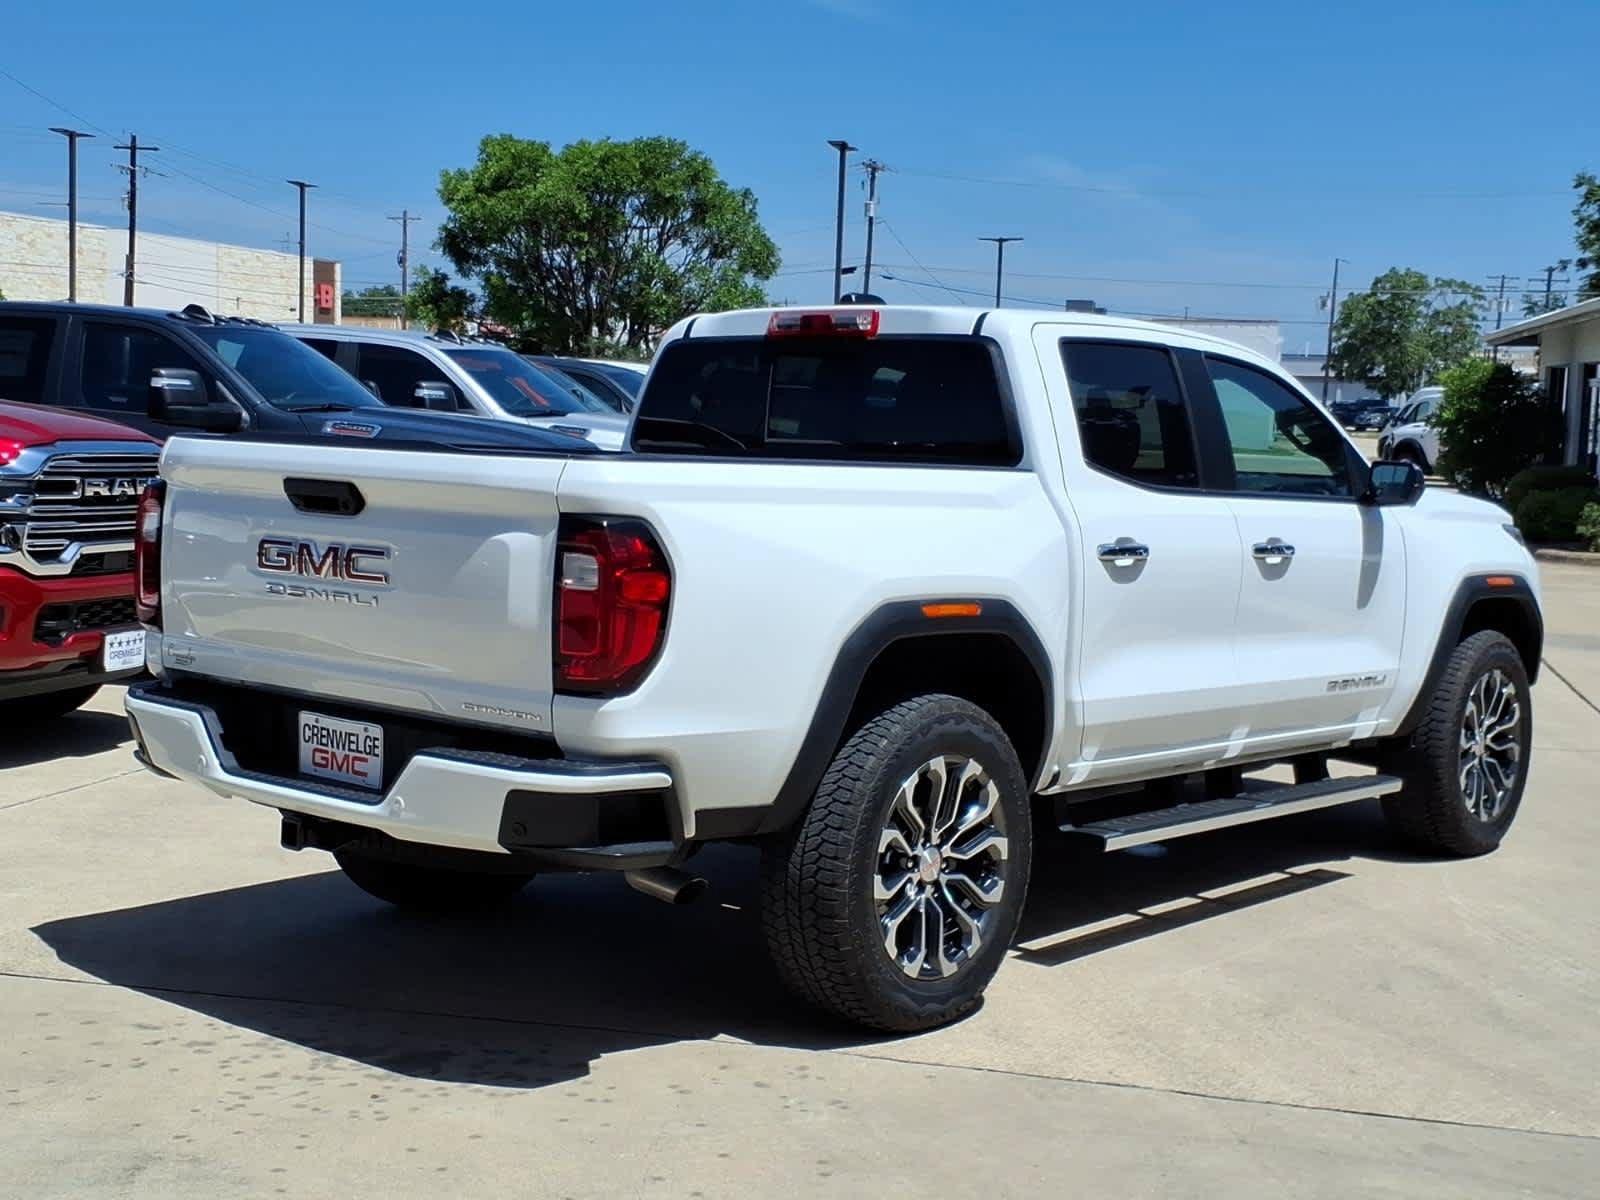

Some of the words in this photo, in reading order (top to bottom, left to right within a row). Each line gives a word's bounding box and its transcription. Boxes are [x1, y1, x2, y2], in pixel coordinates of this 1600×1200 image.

[257, 536, 391, 584] GMC
[264, 581, 380, 608] DENALI
[1327, 673, 1387, 693] DENALI
[461, 702, 542, 721] CANYON
[302, 723, 380, 757] CRENWELGE
[312, 747, 369, 778] GMC
